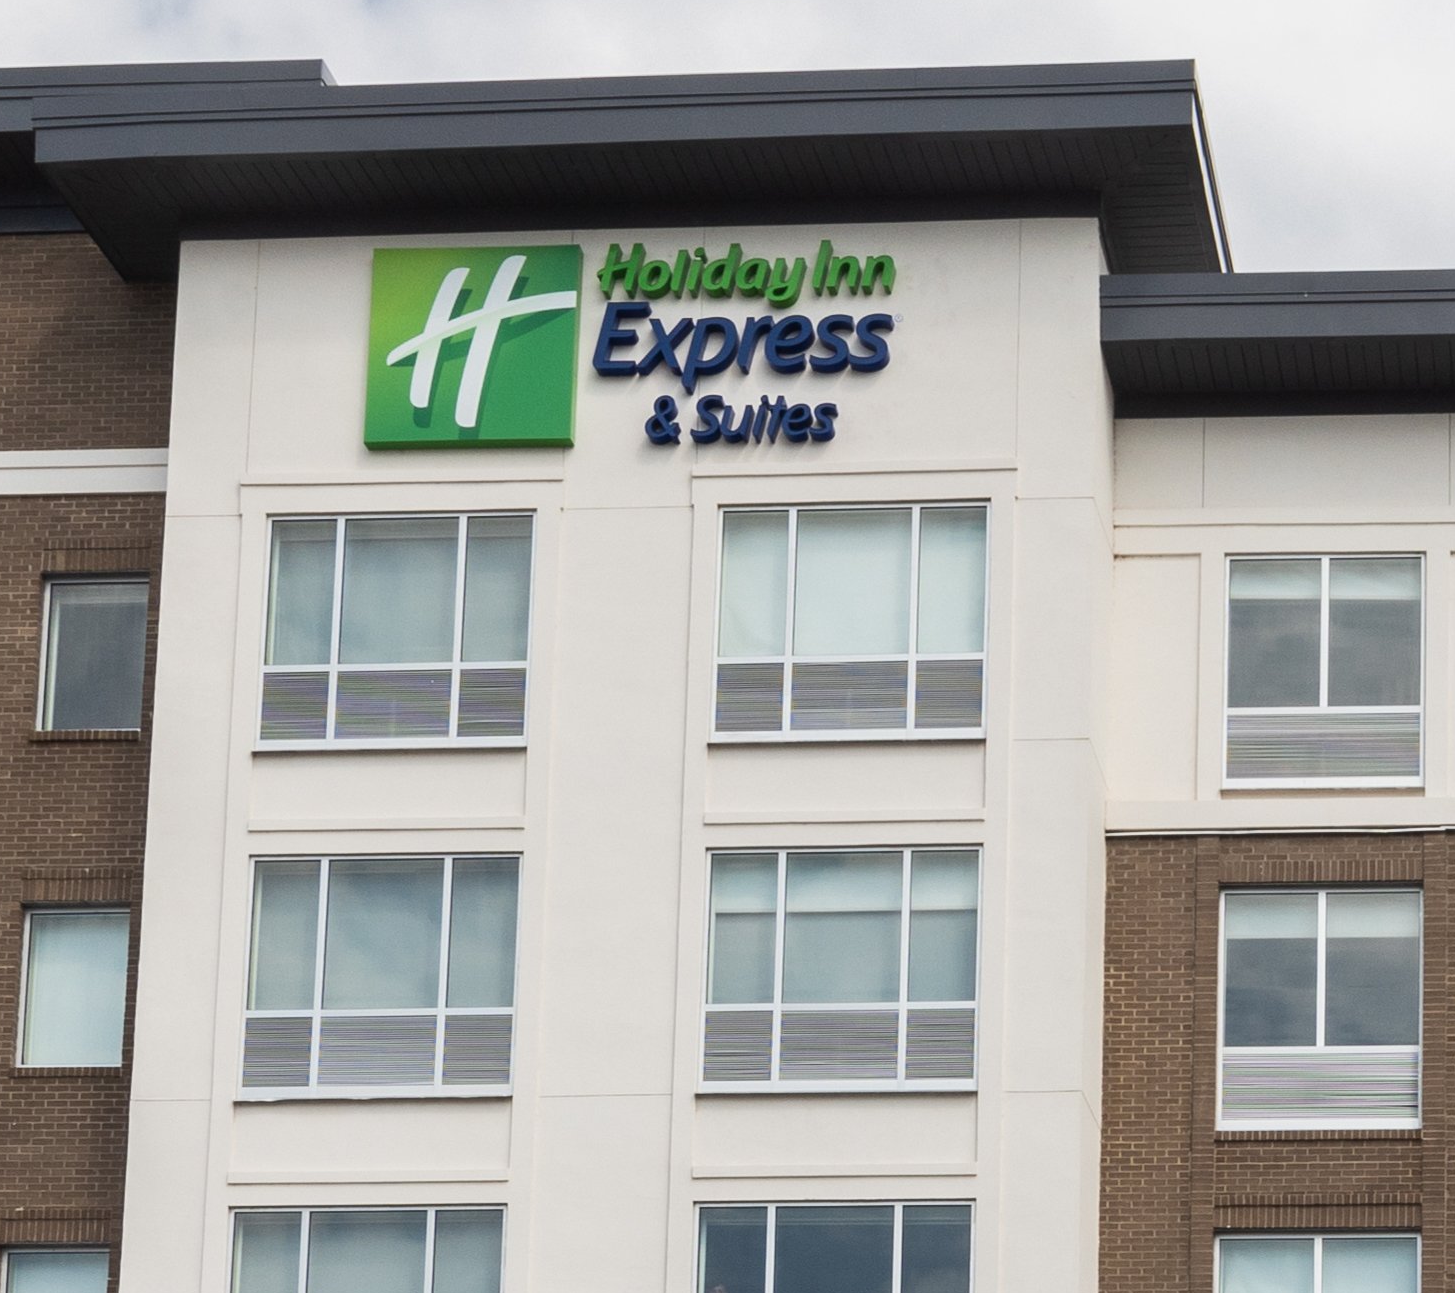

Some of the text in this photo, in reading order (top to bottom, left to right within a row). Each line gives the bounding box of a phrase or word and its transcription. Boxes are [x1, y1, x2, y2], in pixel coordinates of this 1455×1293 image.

[597, 239, 896, 307] Holiday Inn
[593, 302, 895, 395] Express
[645, 394, 838, 445] & Suites
